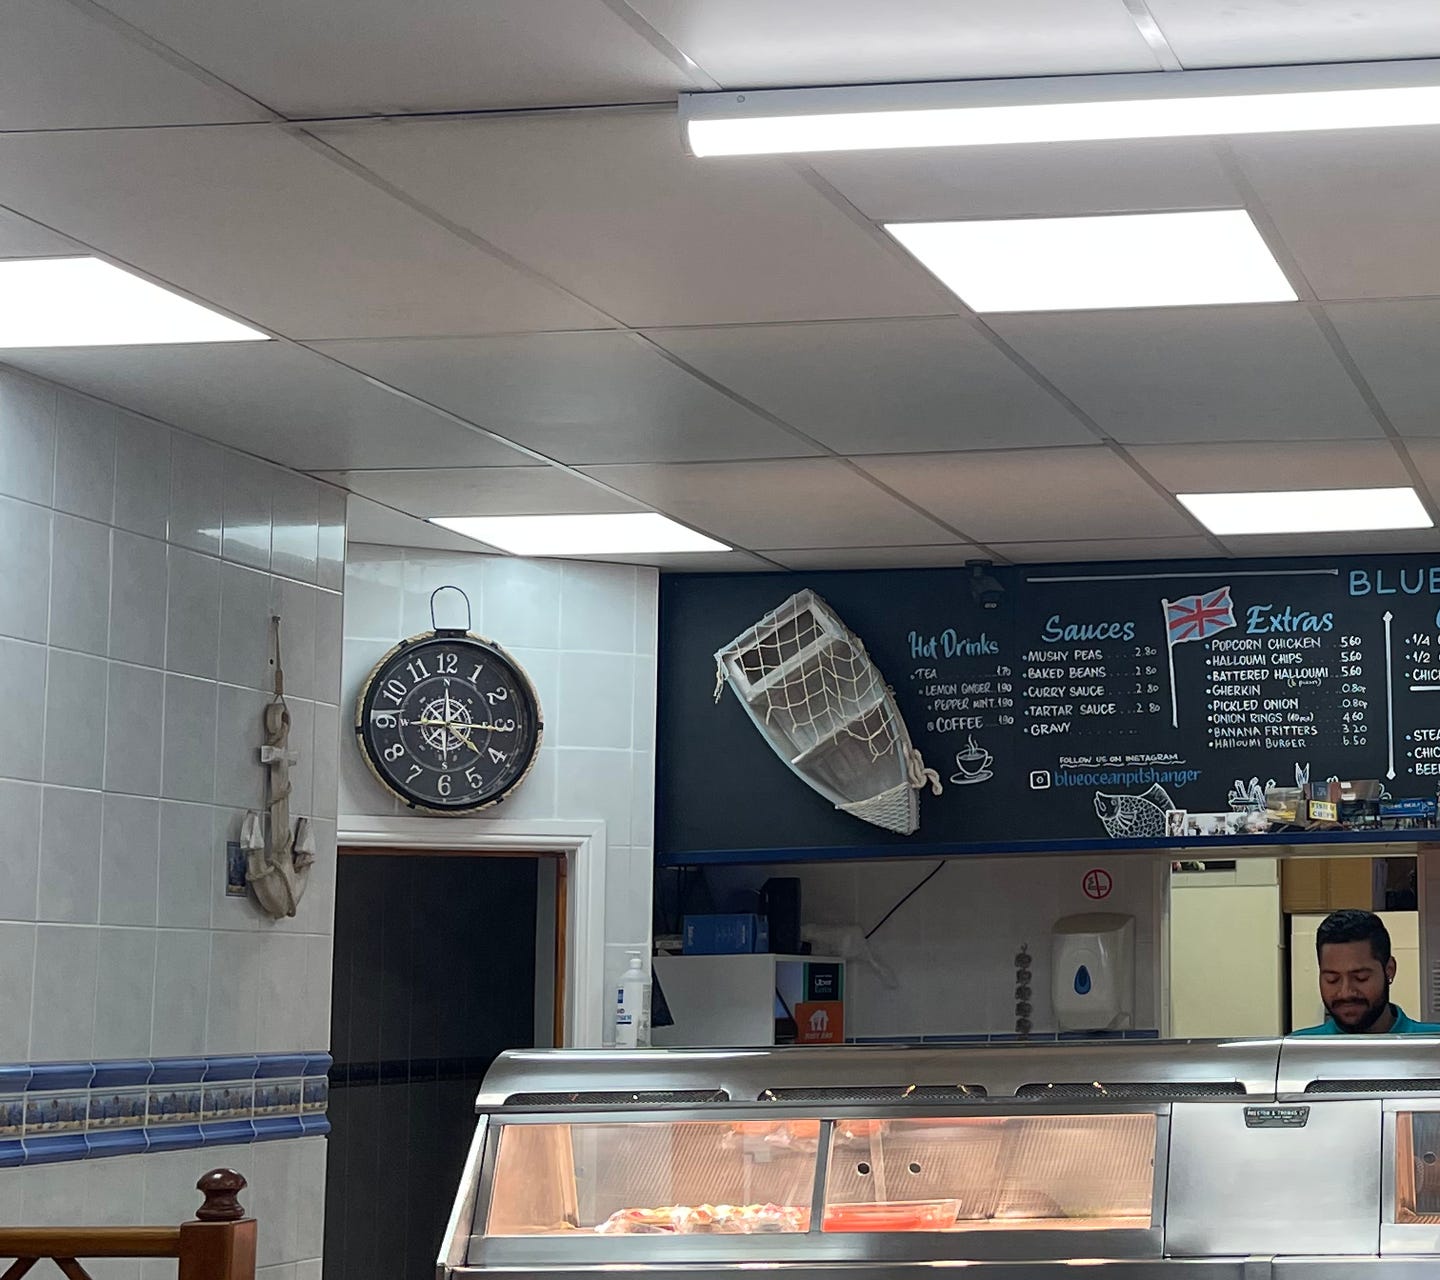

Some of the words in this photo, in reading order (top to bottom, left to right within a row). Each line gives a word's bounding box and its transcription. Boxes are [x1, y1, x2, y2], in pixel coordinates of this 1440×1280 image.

[1246, 604, 1334, 634] Extras
[1041, 615, 1135, 642] Sauces
[908, 631, 938, 659] Hot
[940, 629, 999, 658] Drinks
[1212, 639, 1261, 651] POPCORN
[1268, 637, 1321, 650] CHICKEN
[1412, 634, 1430, 646] 1/4
[1028, 651, 1069, 662] MUSHY
[1074, 650, 1104, 661] PEAS
[1213, 654, 1267, 666] HALLOUMI
[1271, 653, 1303, 665] CHIPS
[1413, 651, 1430, 663] 1/2
[436, 653, 458, 675] 12
[914, 668, 938, 679] TEA
[1028, 668, 1065, 679] BAKED
[1069, 666, 1106, 678] BEANS
[1213, 669, 1269, 682] BATTERED
[1274, 667, 1329, 680] HALLOUMI
[925, 684, 957, 696] LEMON
[1028, 686, 1067, 698] CURRY
[1069, 685, 1105, 697] SAUCE
[1212, 684, 1261, 696] GHERKIN
[934, 697, 969, 711] PEPPER
[1029, 705, 1073, 717] TARTAR
[1079, 703, 1117, 715] SAUCE
[1213, 699, 1259, 712] PICKLED
[1263, 698, 1299, 710] ONION
[936, 716, 984, 733] COFFEE
[1213, 713, 1246, 724] ONION
[1250, 712, 1283, 723] RINGS
[1030, 722, 1071, 736] GRAVY
[1214, 727, 1261, 738] BANANA
[1264, 725, 1318, 737] FRITTERS
[1265, 738, 1307, 749] BURGER
[1059, 756, 1092, 764] FOLLOW
[1054, 767, 1201, 788] blueoceanpitshanger
[437, 774, 452, 796] 6
